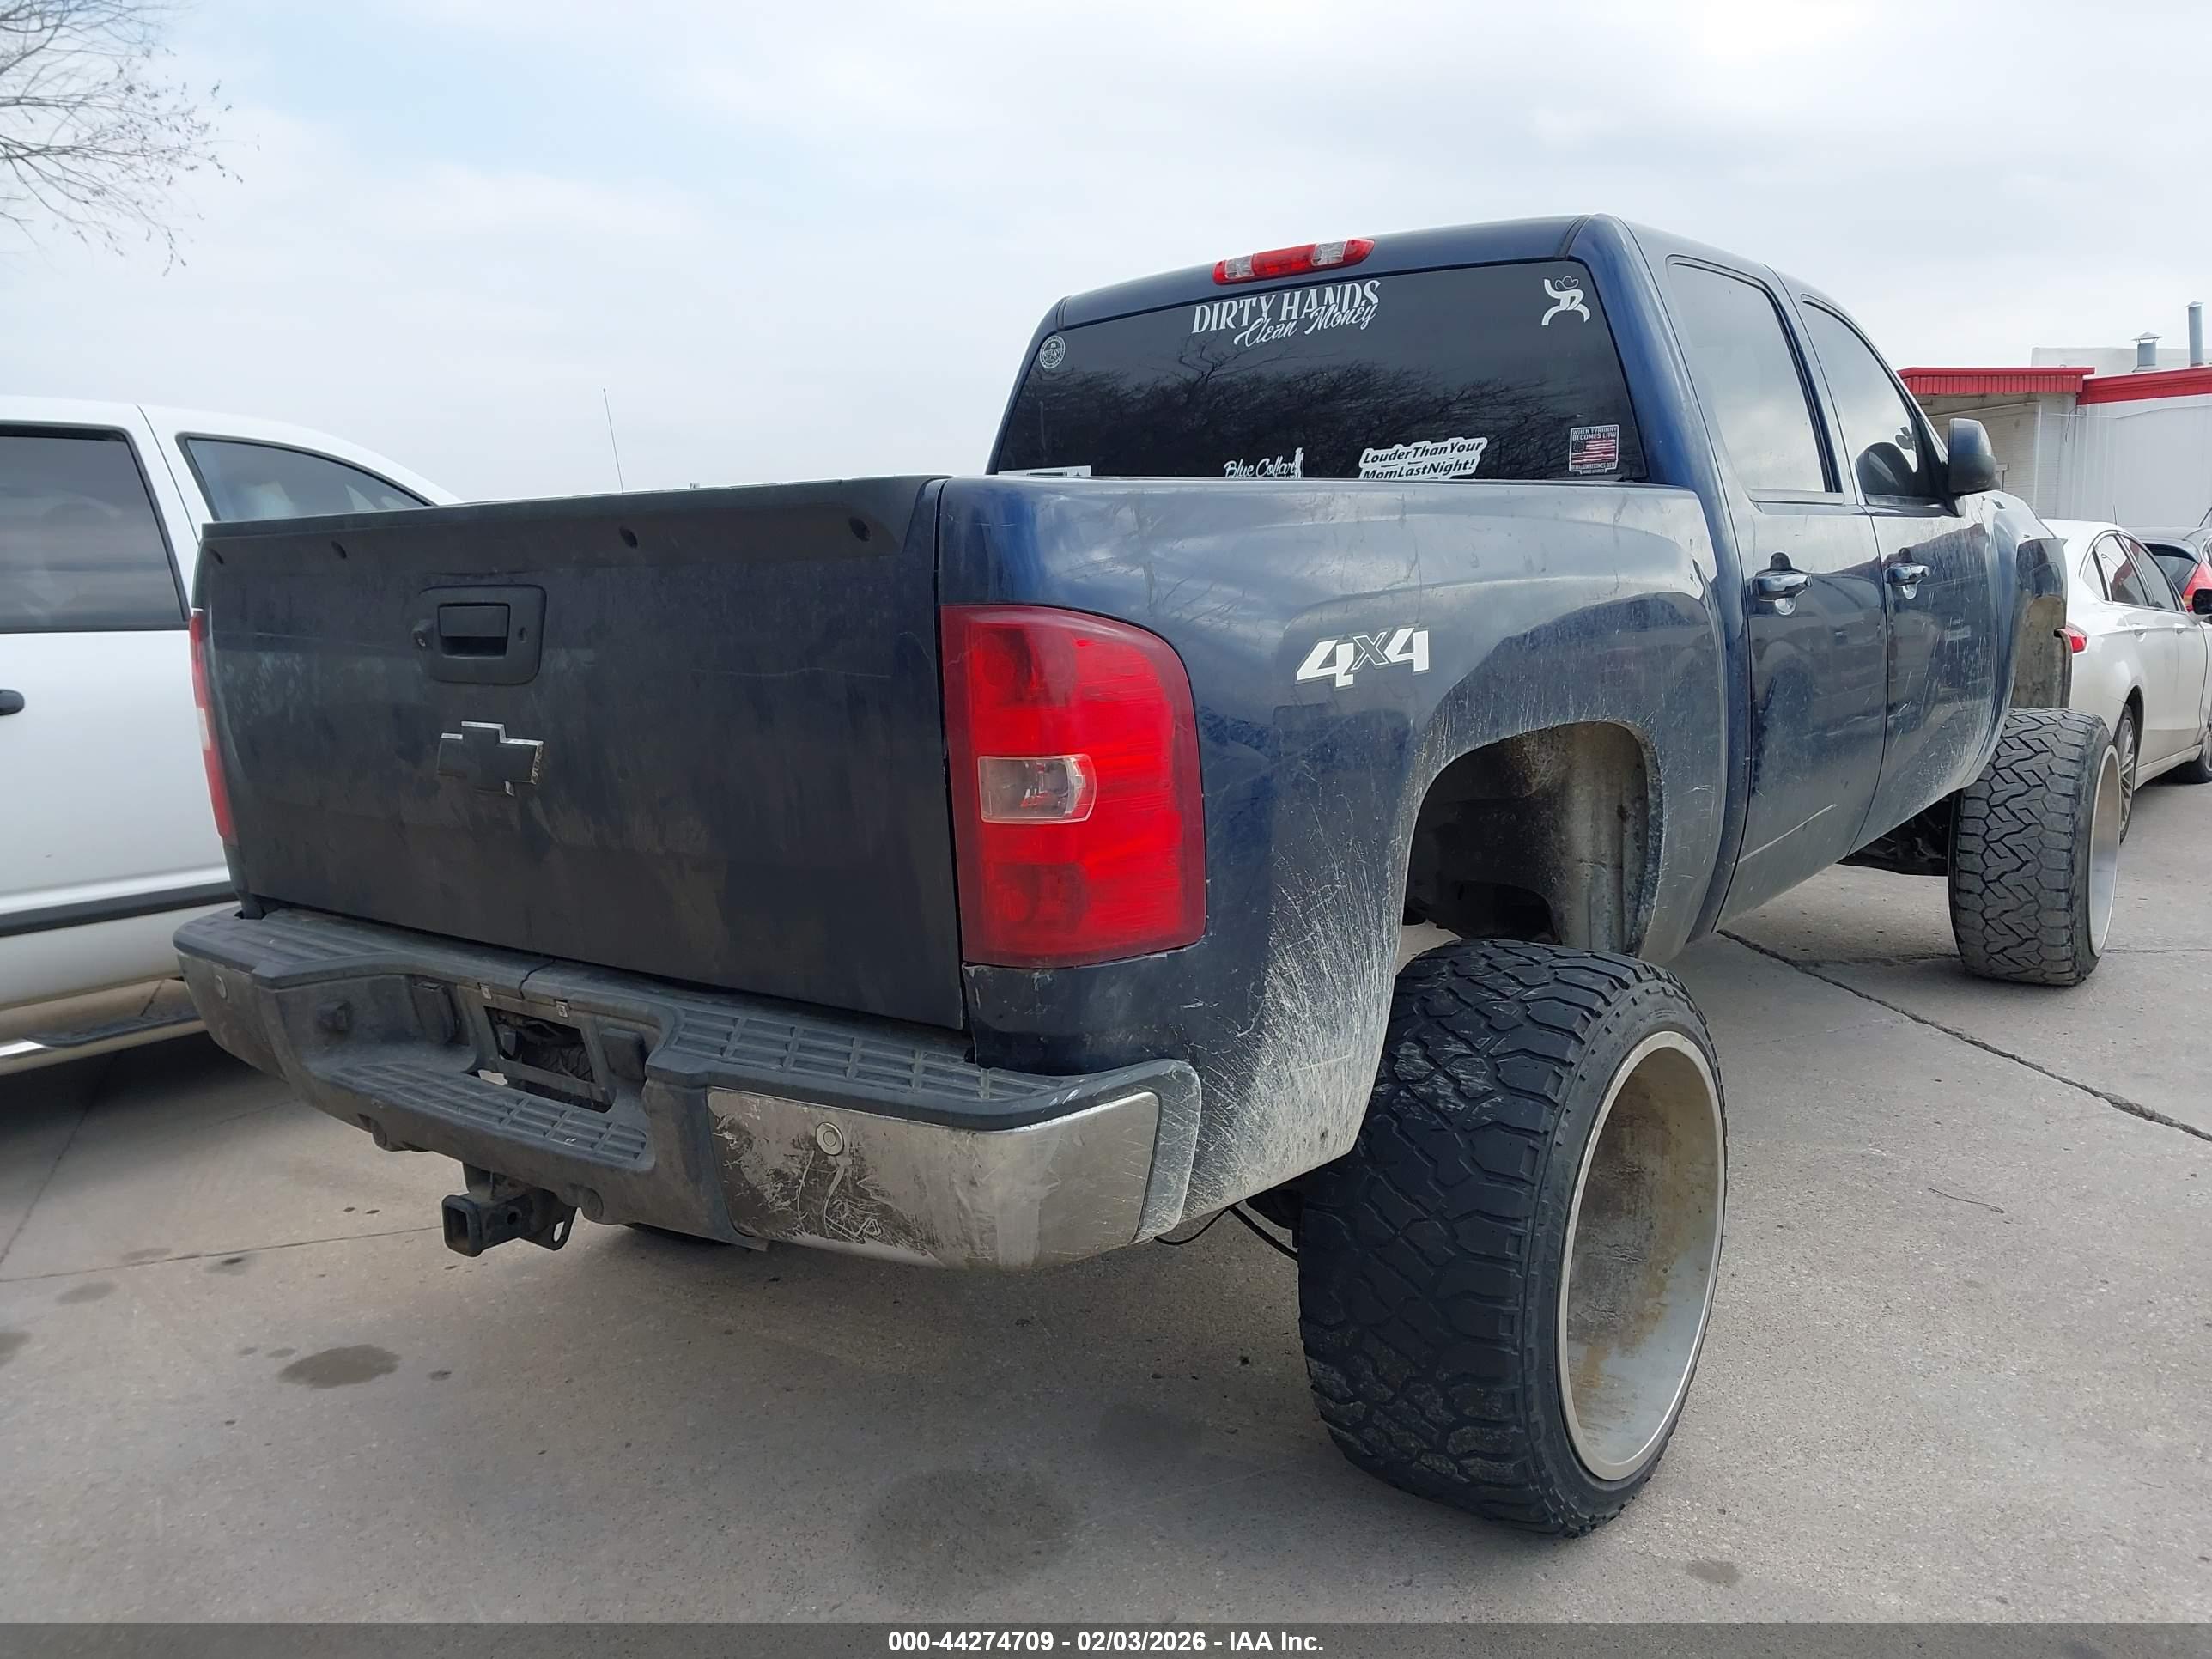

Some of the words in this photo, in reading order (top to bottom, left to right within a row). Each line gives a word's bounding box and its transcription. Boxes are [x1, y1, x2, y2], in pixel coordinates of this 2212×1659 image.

[1191, 295, 1277, 334] DIRTY
[1279, 280, 1381, 322] HANDS
[1233, 317, 1297, 347] Clean
[1304, 303, 1377, 335] Money
[1224, 458, 1255, 478] Blue
[1255, 455, 1295, 477] Collar
